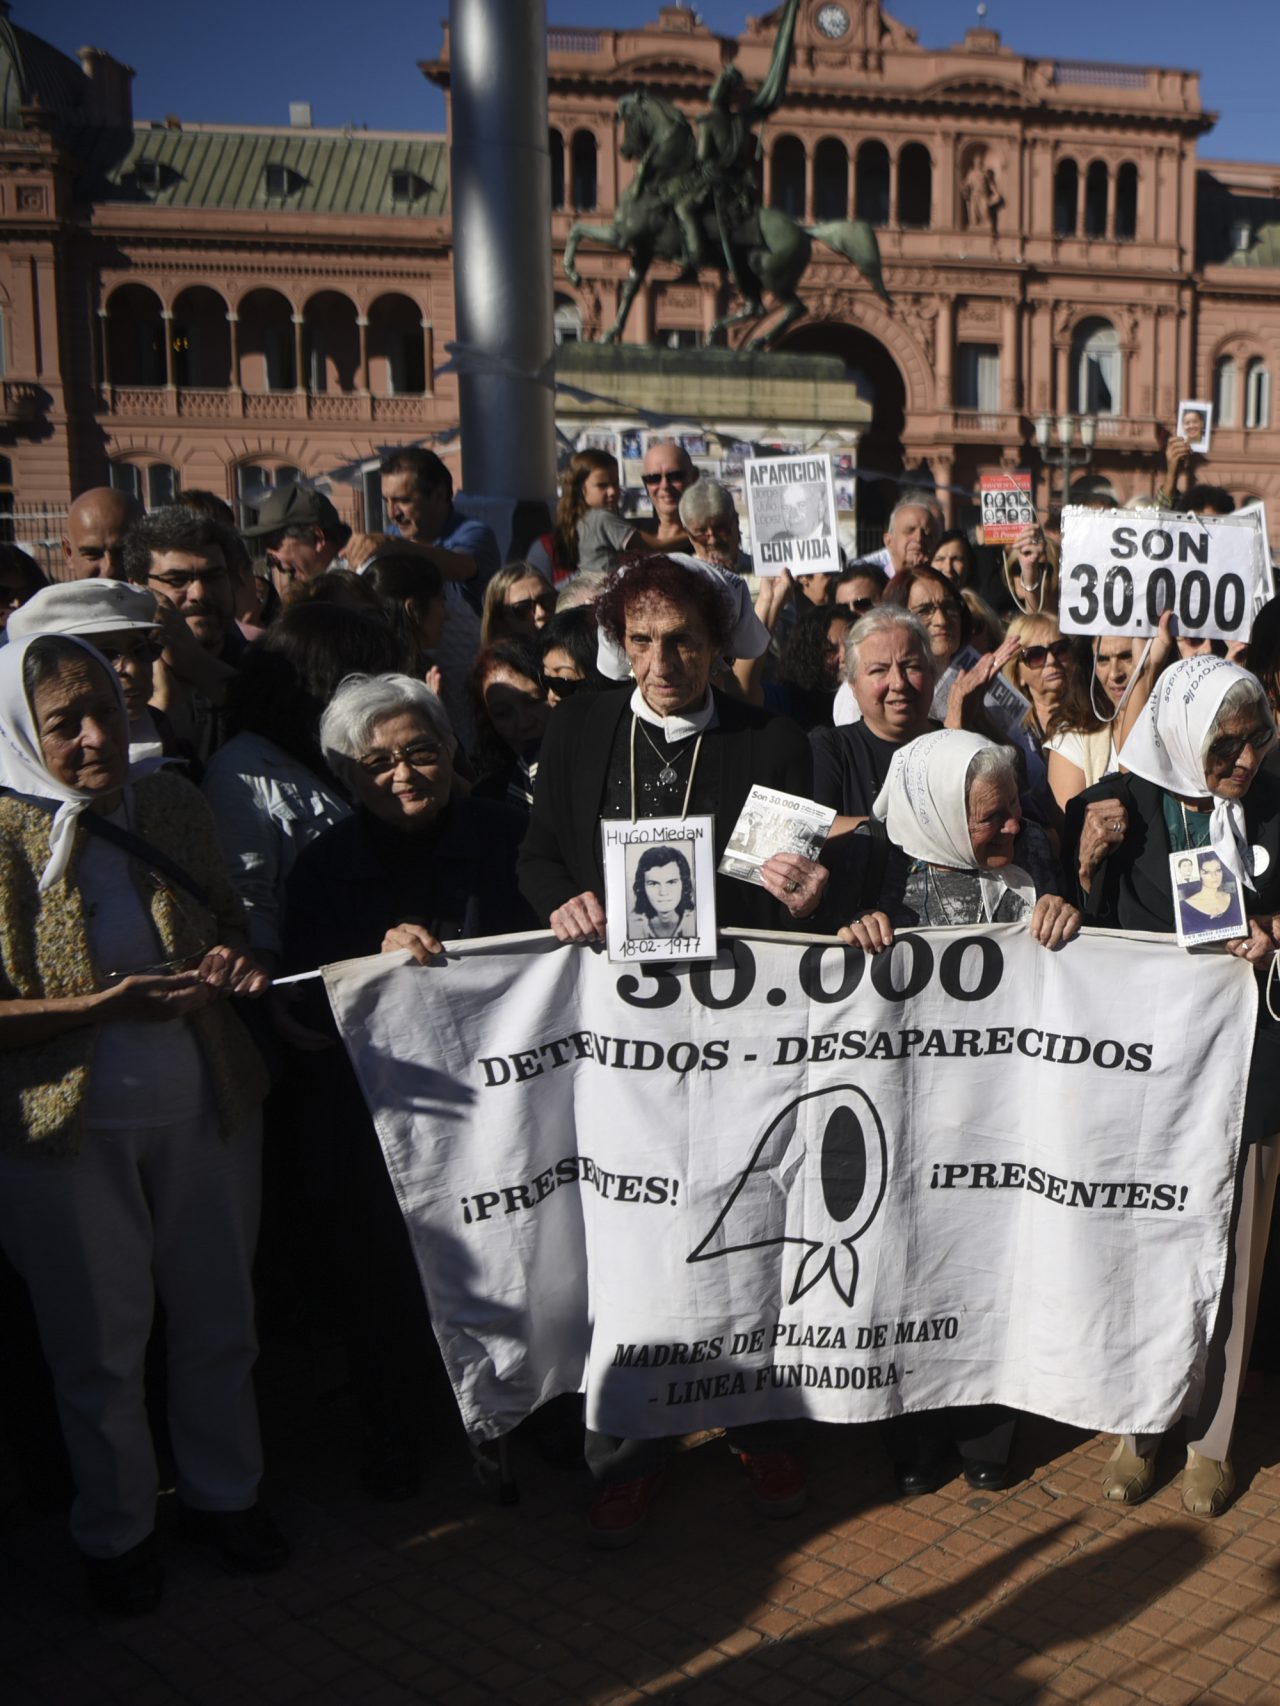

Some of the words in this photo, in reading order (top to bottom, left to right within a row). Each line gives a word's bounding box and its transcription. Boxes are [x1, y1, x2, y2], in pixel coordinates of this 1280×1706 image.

[750, 461, 826, 486] APARICION
[761, 542, 793, 563] CON
[797, 539, 831, 560] VIDA
[1110, 527, 1209, 564] SON
[1068, 563, 1245, 632] 30.000
[751, 790, 768, 802] Son
[768, 795, 800, 811] 30.000
[606, 829, 649, 846] HUGO
[616, 932, 1004, 1009] 30.000
[479, 1031, 730, 1087] DETENIDOS
[744, 1053, 757, 1062] -
[773, 1027, 1153, 1073] DESAPARECIDOS
[463, 1156, 679, 1224] ¡PRESENTES!
[930, 1162, 1189, 1211] ¡PRESENTES!
[611, 1336, 724, 1367] MADRES
[730, 1329, 765, 1357] DE
[769, 1324, 847, 1349] PLAZA
[855, 1324, 889, 1350] DE
[894, 1317, 959, 1344] MAYO
[666, 1372, 746, 1407] LINEA
[754, 1363, 899, 1392] FUNDADORA
